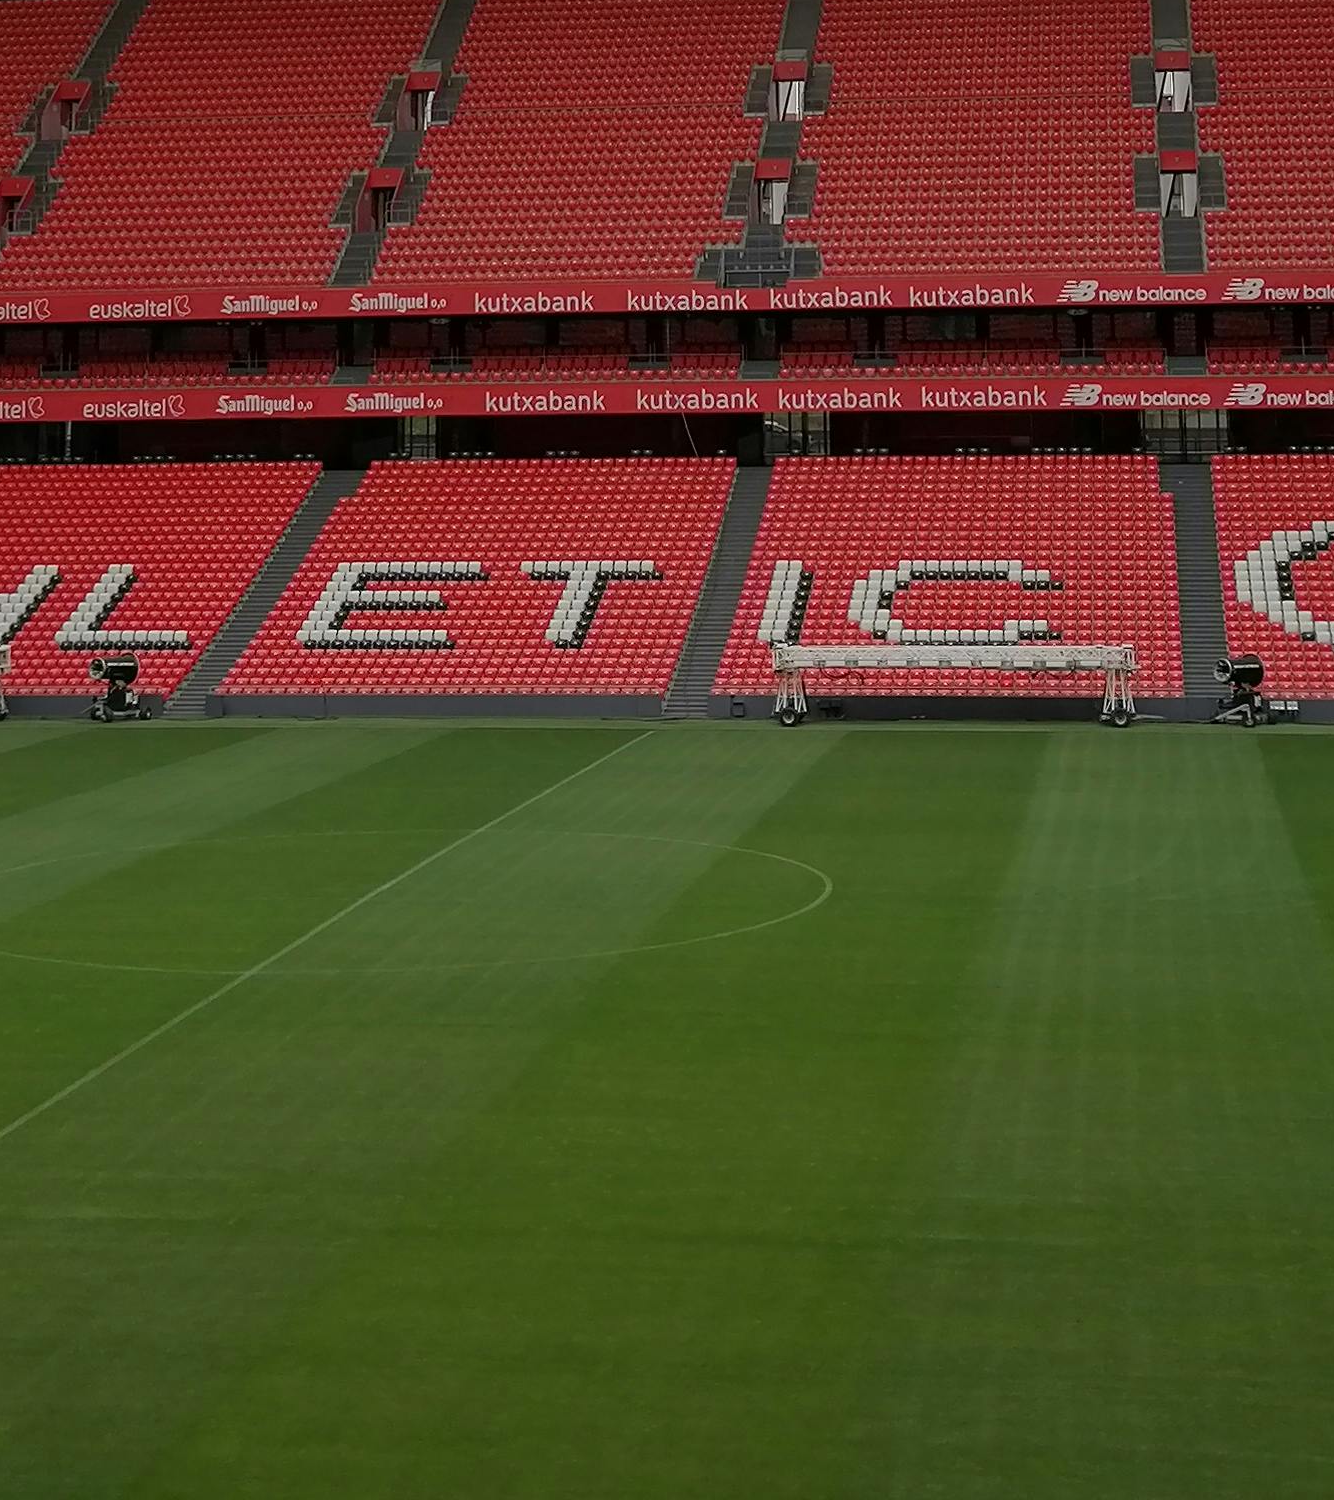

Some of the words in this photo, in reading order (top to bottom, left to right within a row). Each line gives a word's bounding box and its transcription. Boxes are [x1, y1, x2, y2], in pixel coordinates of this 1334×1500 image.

[475, 290, 593, 313] kutxabank
[628, 289, 748, 311] kutxabank
[770, 285, 892, 309] kutxabank
[910, 282, 1035, 307] kutxabank
[1099, 289, 1133, 302] new
[1137, 286, 1207, 301] balance
[1265, 288, 1300, 300] new
[90, 299, 171, 318] euskaltel
[486, 390, 605, 412] kutxabank
[637, 388, 758, 410] kutxabank
[779, 387, 902, 410] kutxabank
[922, 385, 1047, 408] kutxabank
[1102, 394, 1137, 406] new
[1140, 391, 1211, 406] balance
[1267, 393, 1302, 406] new
[83, 398, 166, 418] euskaltel
